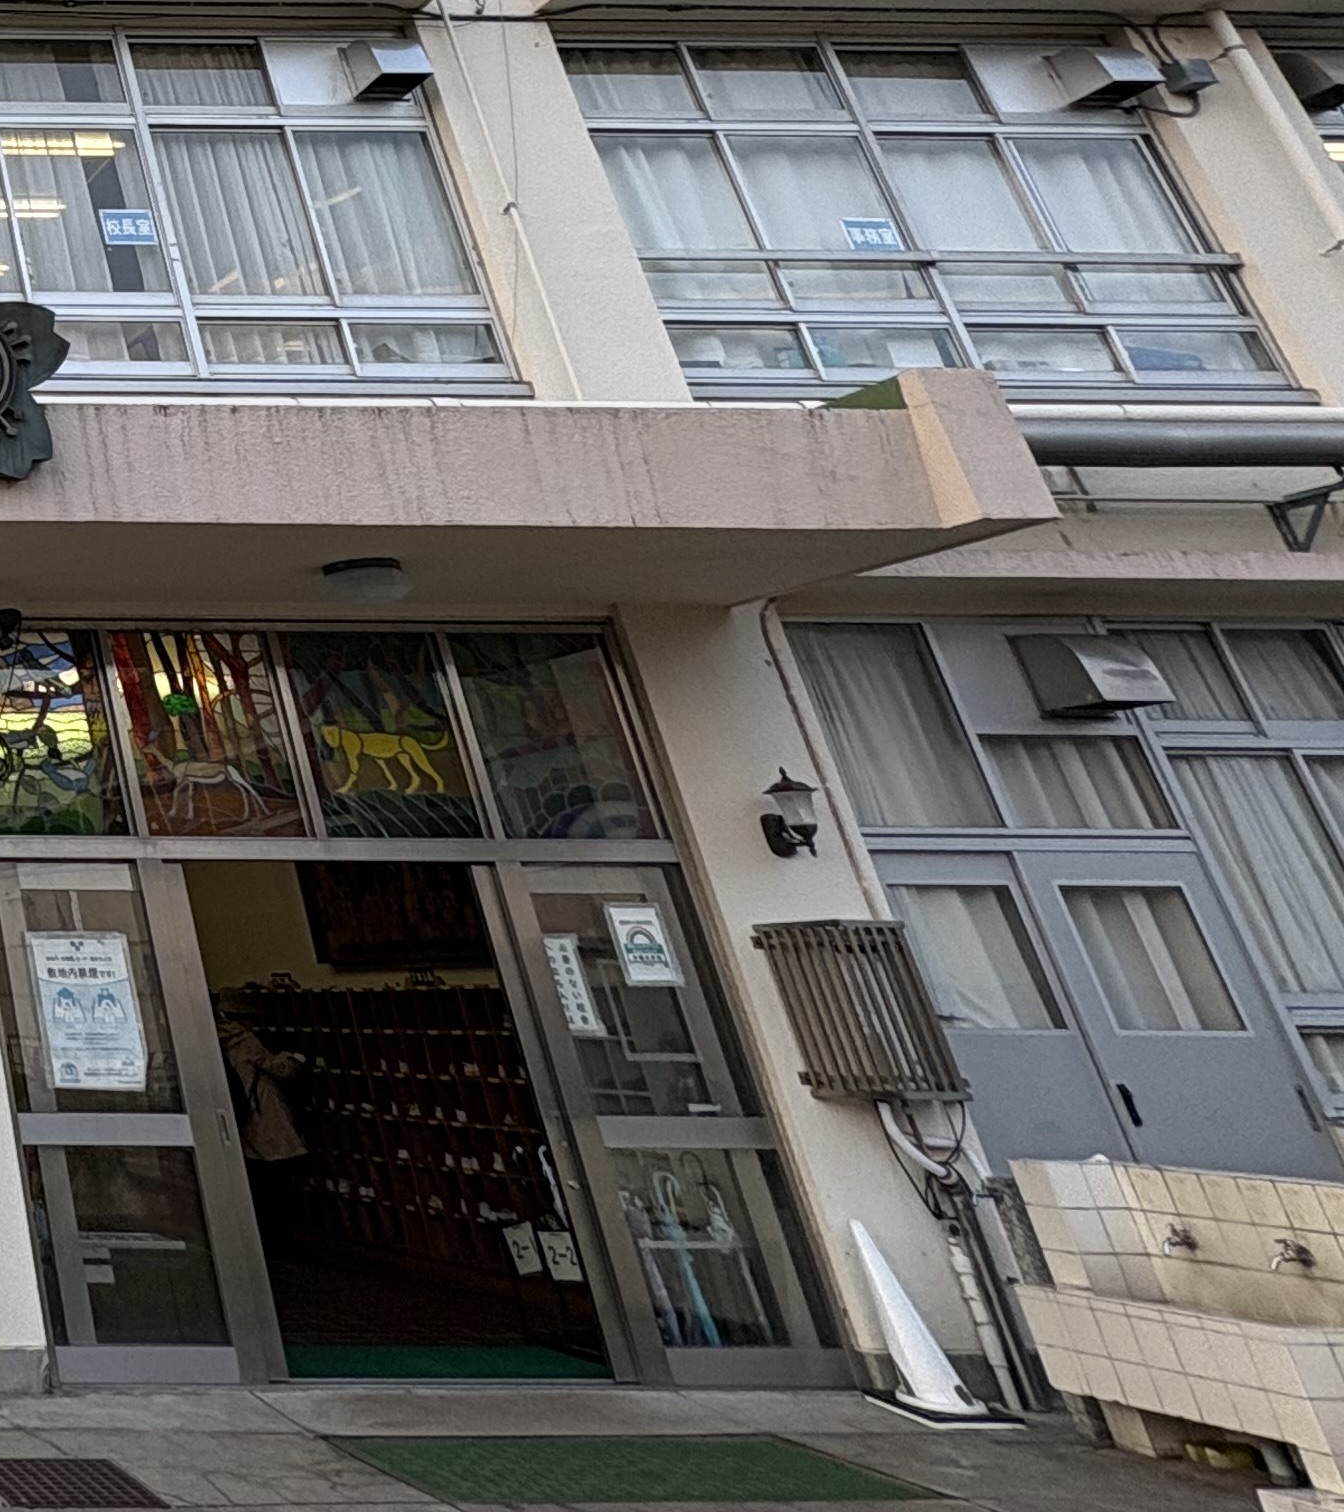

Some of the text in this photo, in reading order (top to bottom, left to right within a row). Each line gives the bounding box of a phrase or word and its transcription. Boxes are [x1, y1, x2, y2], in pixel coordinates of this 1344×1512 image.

[106, 219, 154, 235] 校長室
[548, 1246, 577, 1266] 2-2
